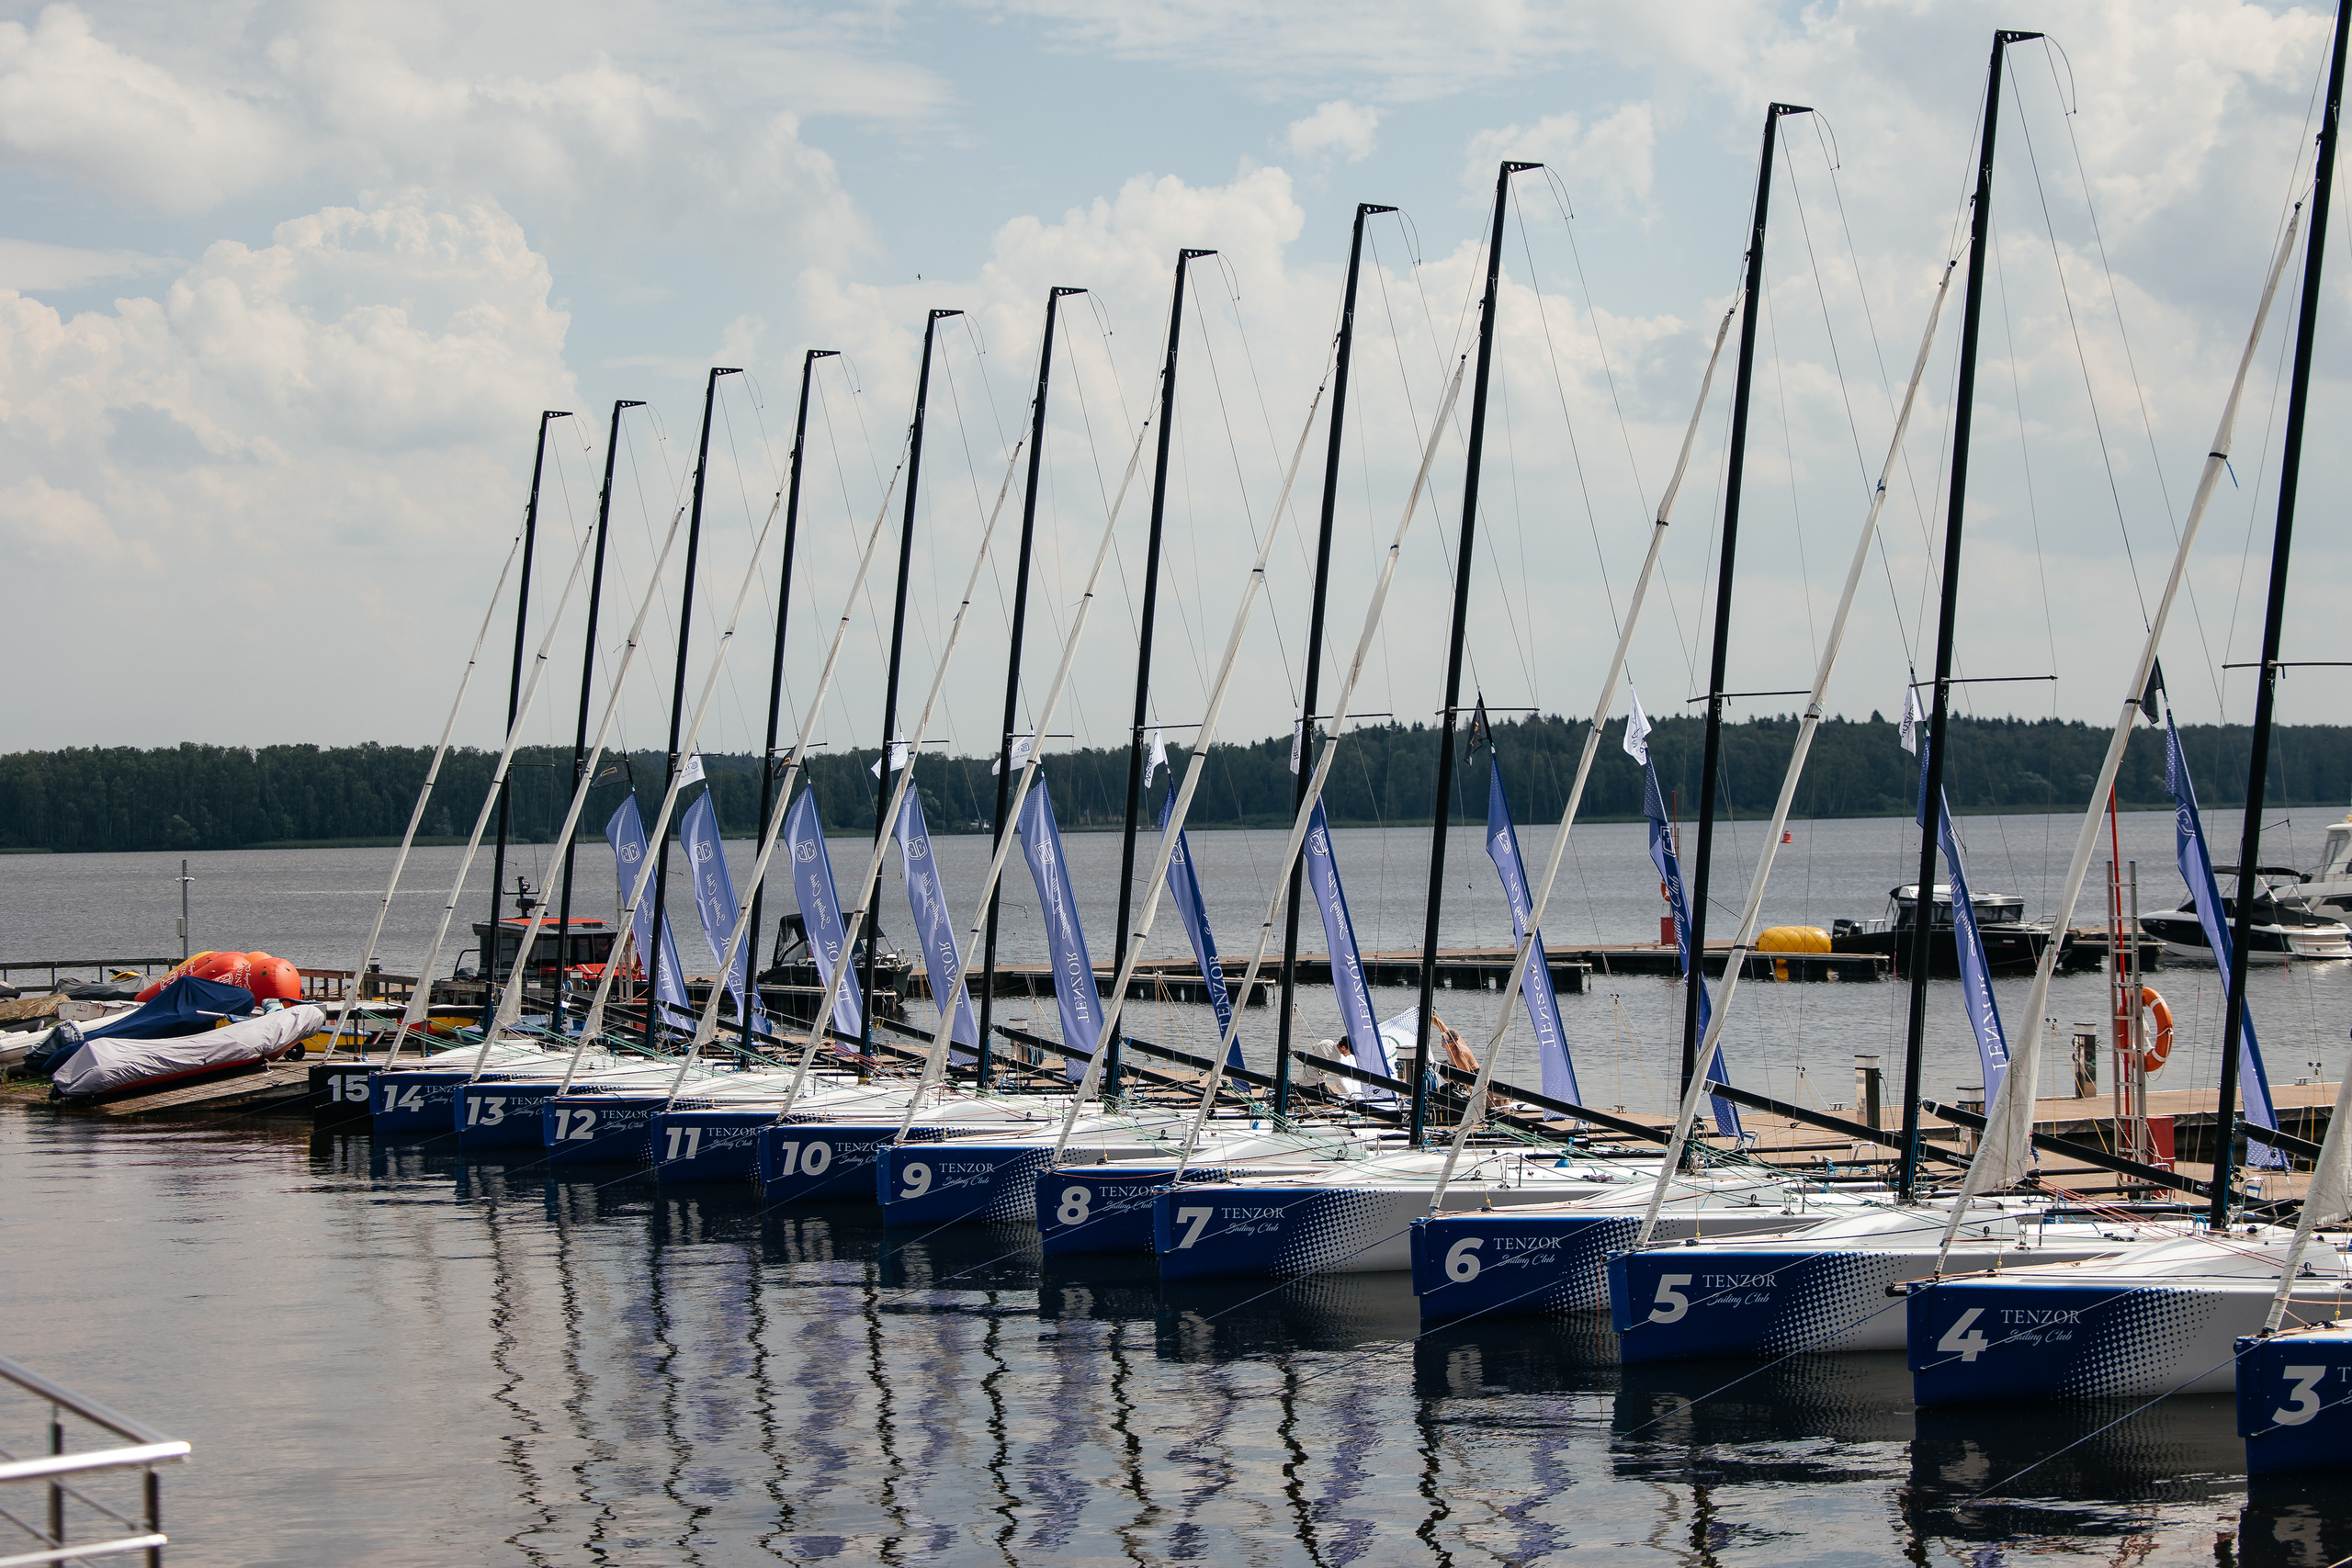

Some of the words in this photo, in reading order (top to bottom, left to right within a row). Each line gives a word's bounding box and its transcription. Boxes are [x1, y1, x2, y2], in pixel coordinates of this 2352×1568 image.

[1209, 955, 1232, 1032] TENZOR
[327, 1075, 370, 1101] 15
[384, 1085, 424, 1111] 14
[424, 1085, 454, 1093] TENZ
[467, 1097, 506, 1125] 13
[601, 1110, 649, 1119] TENZOR
[555, 1109, 596, 1139] 12
[707, 1127, 757, 1137] TENZOR
[666, 1127, 701, 1159] 11
[782, 1141, 831, 1176] 10
[939, 1163, 994, 1173] TENZOR
[899, 1162, 932, 1199] 9
[942, 1176, 969, 1188] Sailing
[970, 1176, 989, 1186] Club
[1057, 1186, 1091, 1225] 8
[1132, 1201, 1153, 1211] Club
[1221, 1207, 1285, 1219] TENZOR
[1176, 1207, 1214, 1248] 7
[1225, 1223, 1255, 1235] Sailing
[1257, 1223, 1279, 1234] Club
[1493, 1237, 1562, 1249] TENZOR
[1445, 1237, 1484, 1282] 6
[1498, 1254, 1530, 1269] Sailing
[1532, 1253, 1555, 1265] Club
[1702, 1274, 1777, 1288] TENZOR
[1648, 1274, 1692, 1324] 5
[1706, 1293, 1742, 1308] Sailing
[1744, 1292, 1770, 1304] Club
[2001, 1309, 2081, 1324] TENZOR
[1937, 1308, 1989, 1361] 4
[2005, 1329, 2042, 1346] Sailing
[2045, 1329, 2073, 1343] Club
[2271, 1365, 2326, 1426] 3
